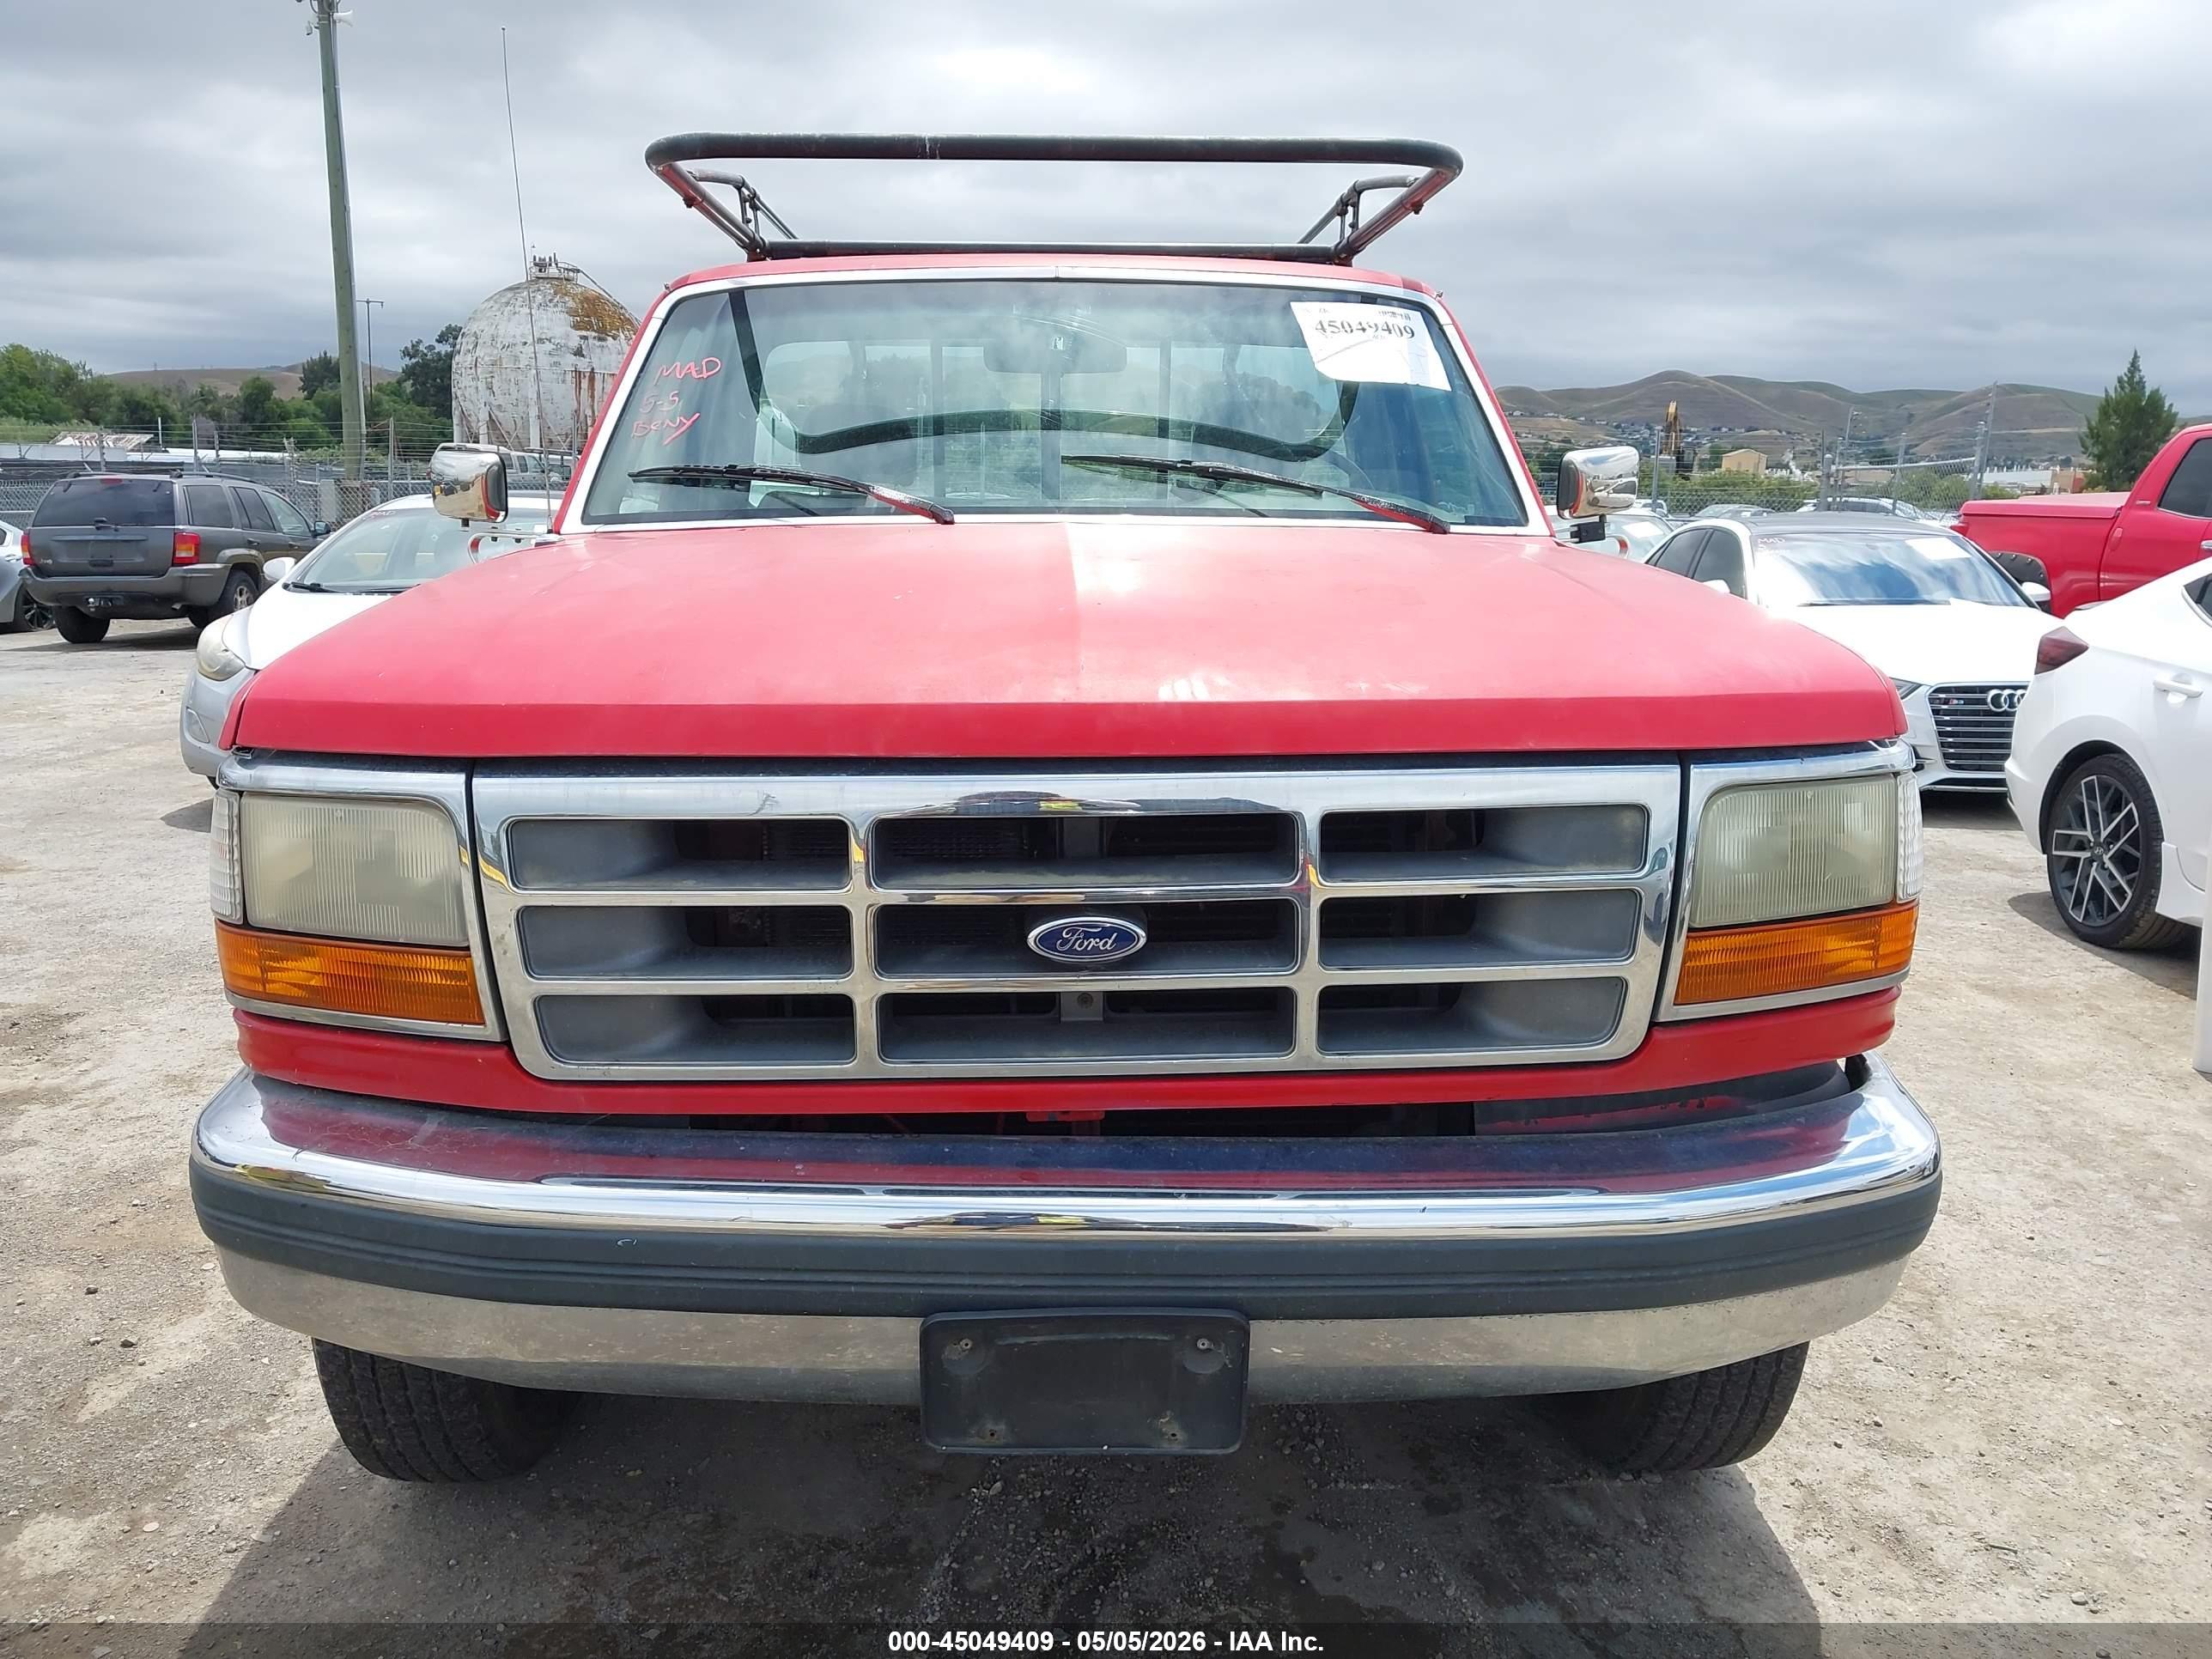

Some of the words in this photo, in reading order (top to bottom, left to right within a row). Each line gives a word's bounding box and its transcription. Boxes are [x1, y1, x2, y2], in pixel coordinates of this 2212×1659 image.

[1315, 319, 1415, 339] 45049409
[653, 356, 721, 386] MAD
[1056, 927, 1118, 951] Ford
